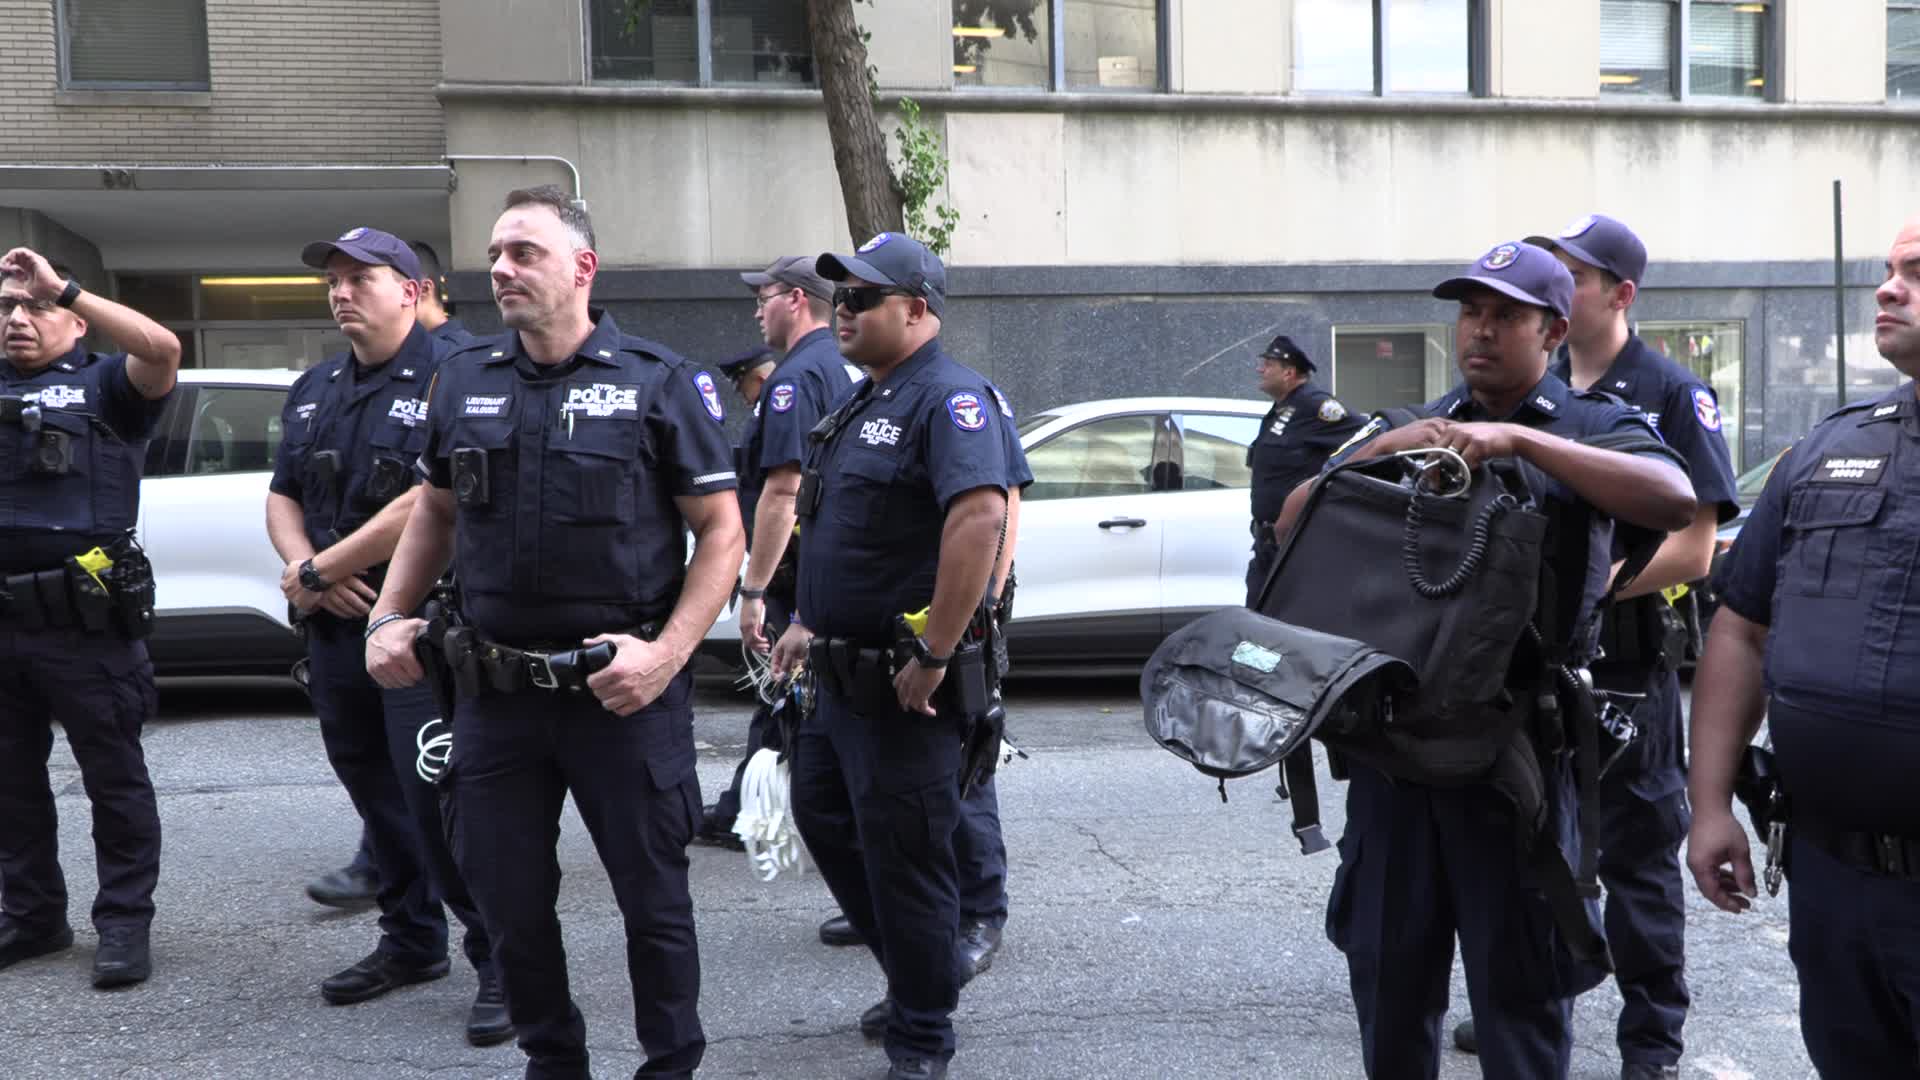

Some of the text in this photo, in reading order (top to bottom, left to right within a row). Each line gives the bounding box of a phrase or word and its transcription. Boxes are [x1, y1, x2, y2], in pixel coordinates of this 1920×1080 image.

[39, 389, 85, 400] OLICE
[568, 388, 637, 404] POLICE
[1536, 396, 1556, 410] DCU
[860, 421, 902, 441] POLICE
